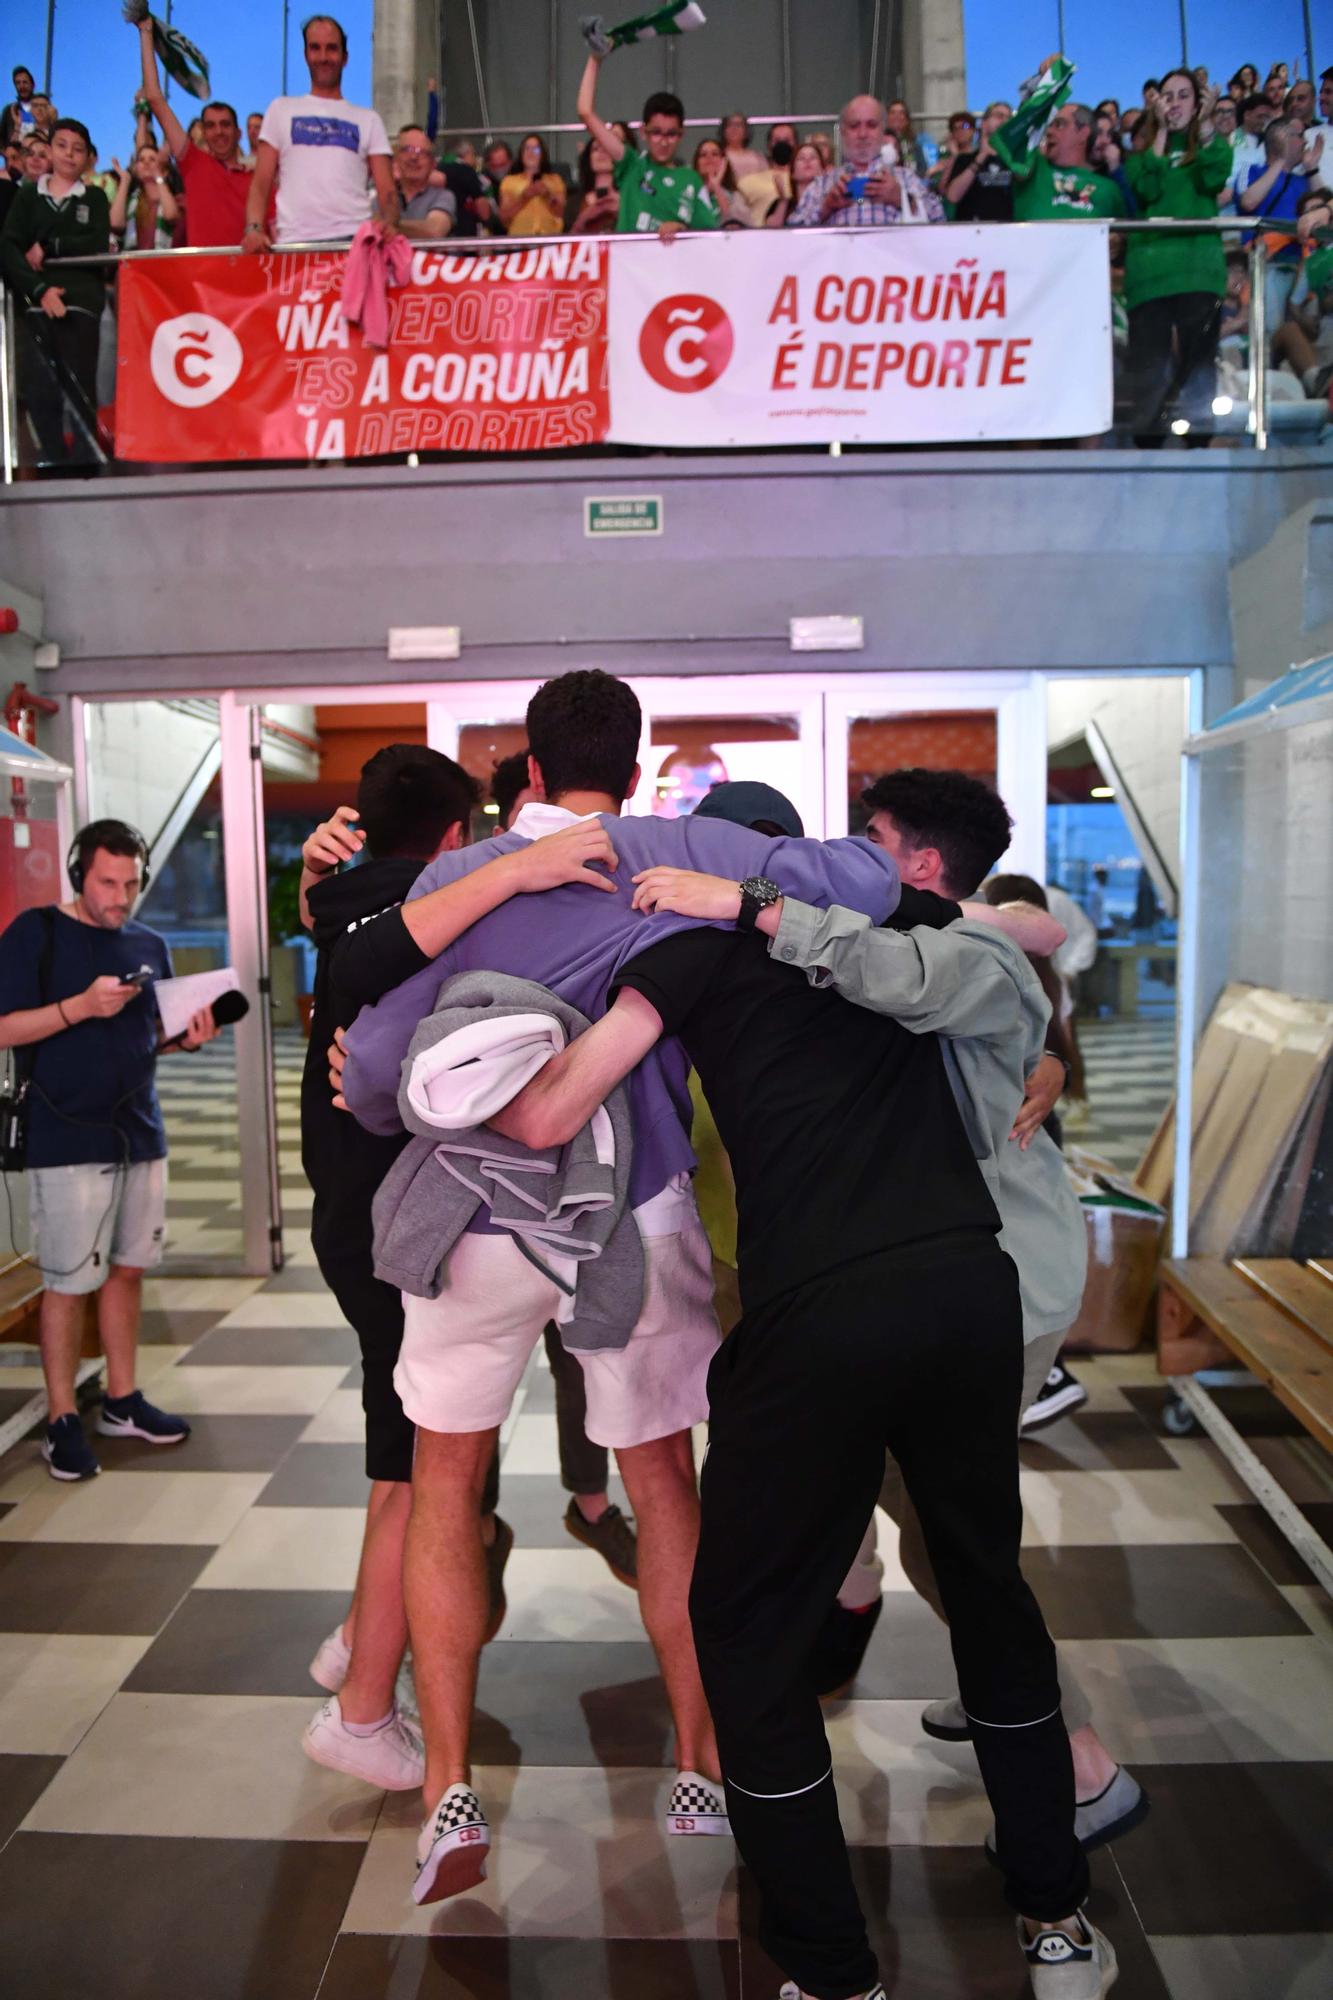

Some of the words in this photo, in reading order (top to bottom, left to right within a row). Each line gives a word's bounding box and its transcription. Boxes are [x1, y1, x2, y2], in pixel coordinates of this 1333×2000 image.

[767, 275, 798, 324] A
[814, 258, 1006, 325] CORUÑA
[360, 354, 390, 407] A
[401, 340, 589, 403] CORUÑA
[771, 329, 804, 390] É
[811, 337, 1033, 391] DEPORTE
[355, 401, 596, 456] DEPORTES
